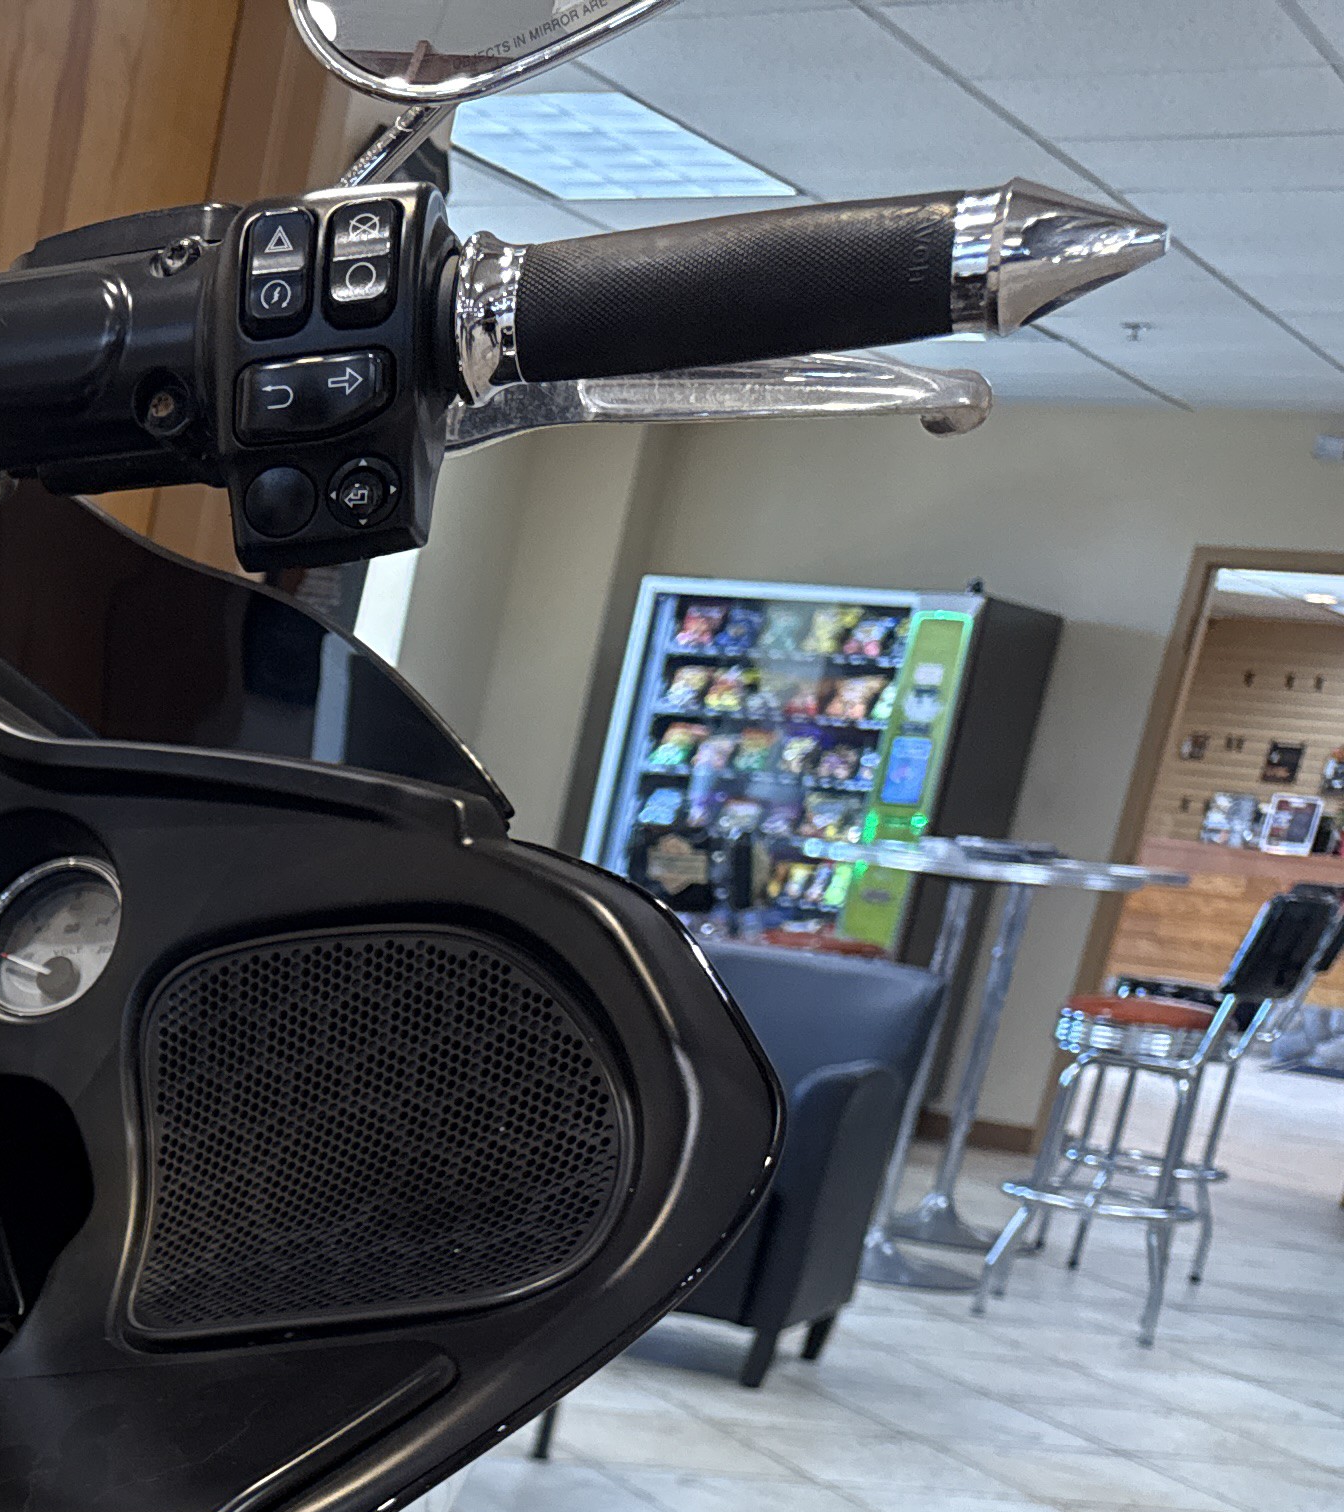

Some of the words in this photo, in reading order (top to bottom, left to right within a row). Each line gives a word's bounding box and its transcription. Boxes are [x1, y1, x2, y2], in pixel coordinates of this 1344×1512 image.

[512, 32, 527, 49] IN
[529, 14, 580, 41] MIRROR
[582, 0, 609, 22] ARE
